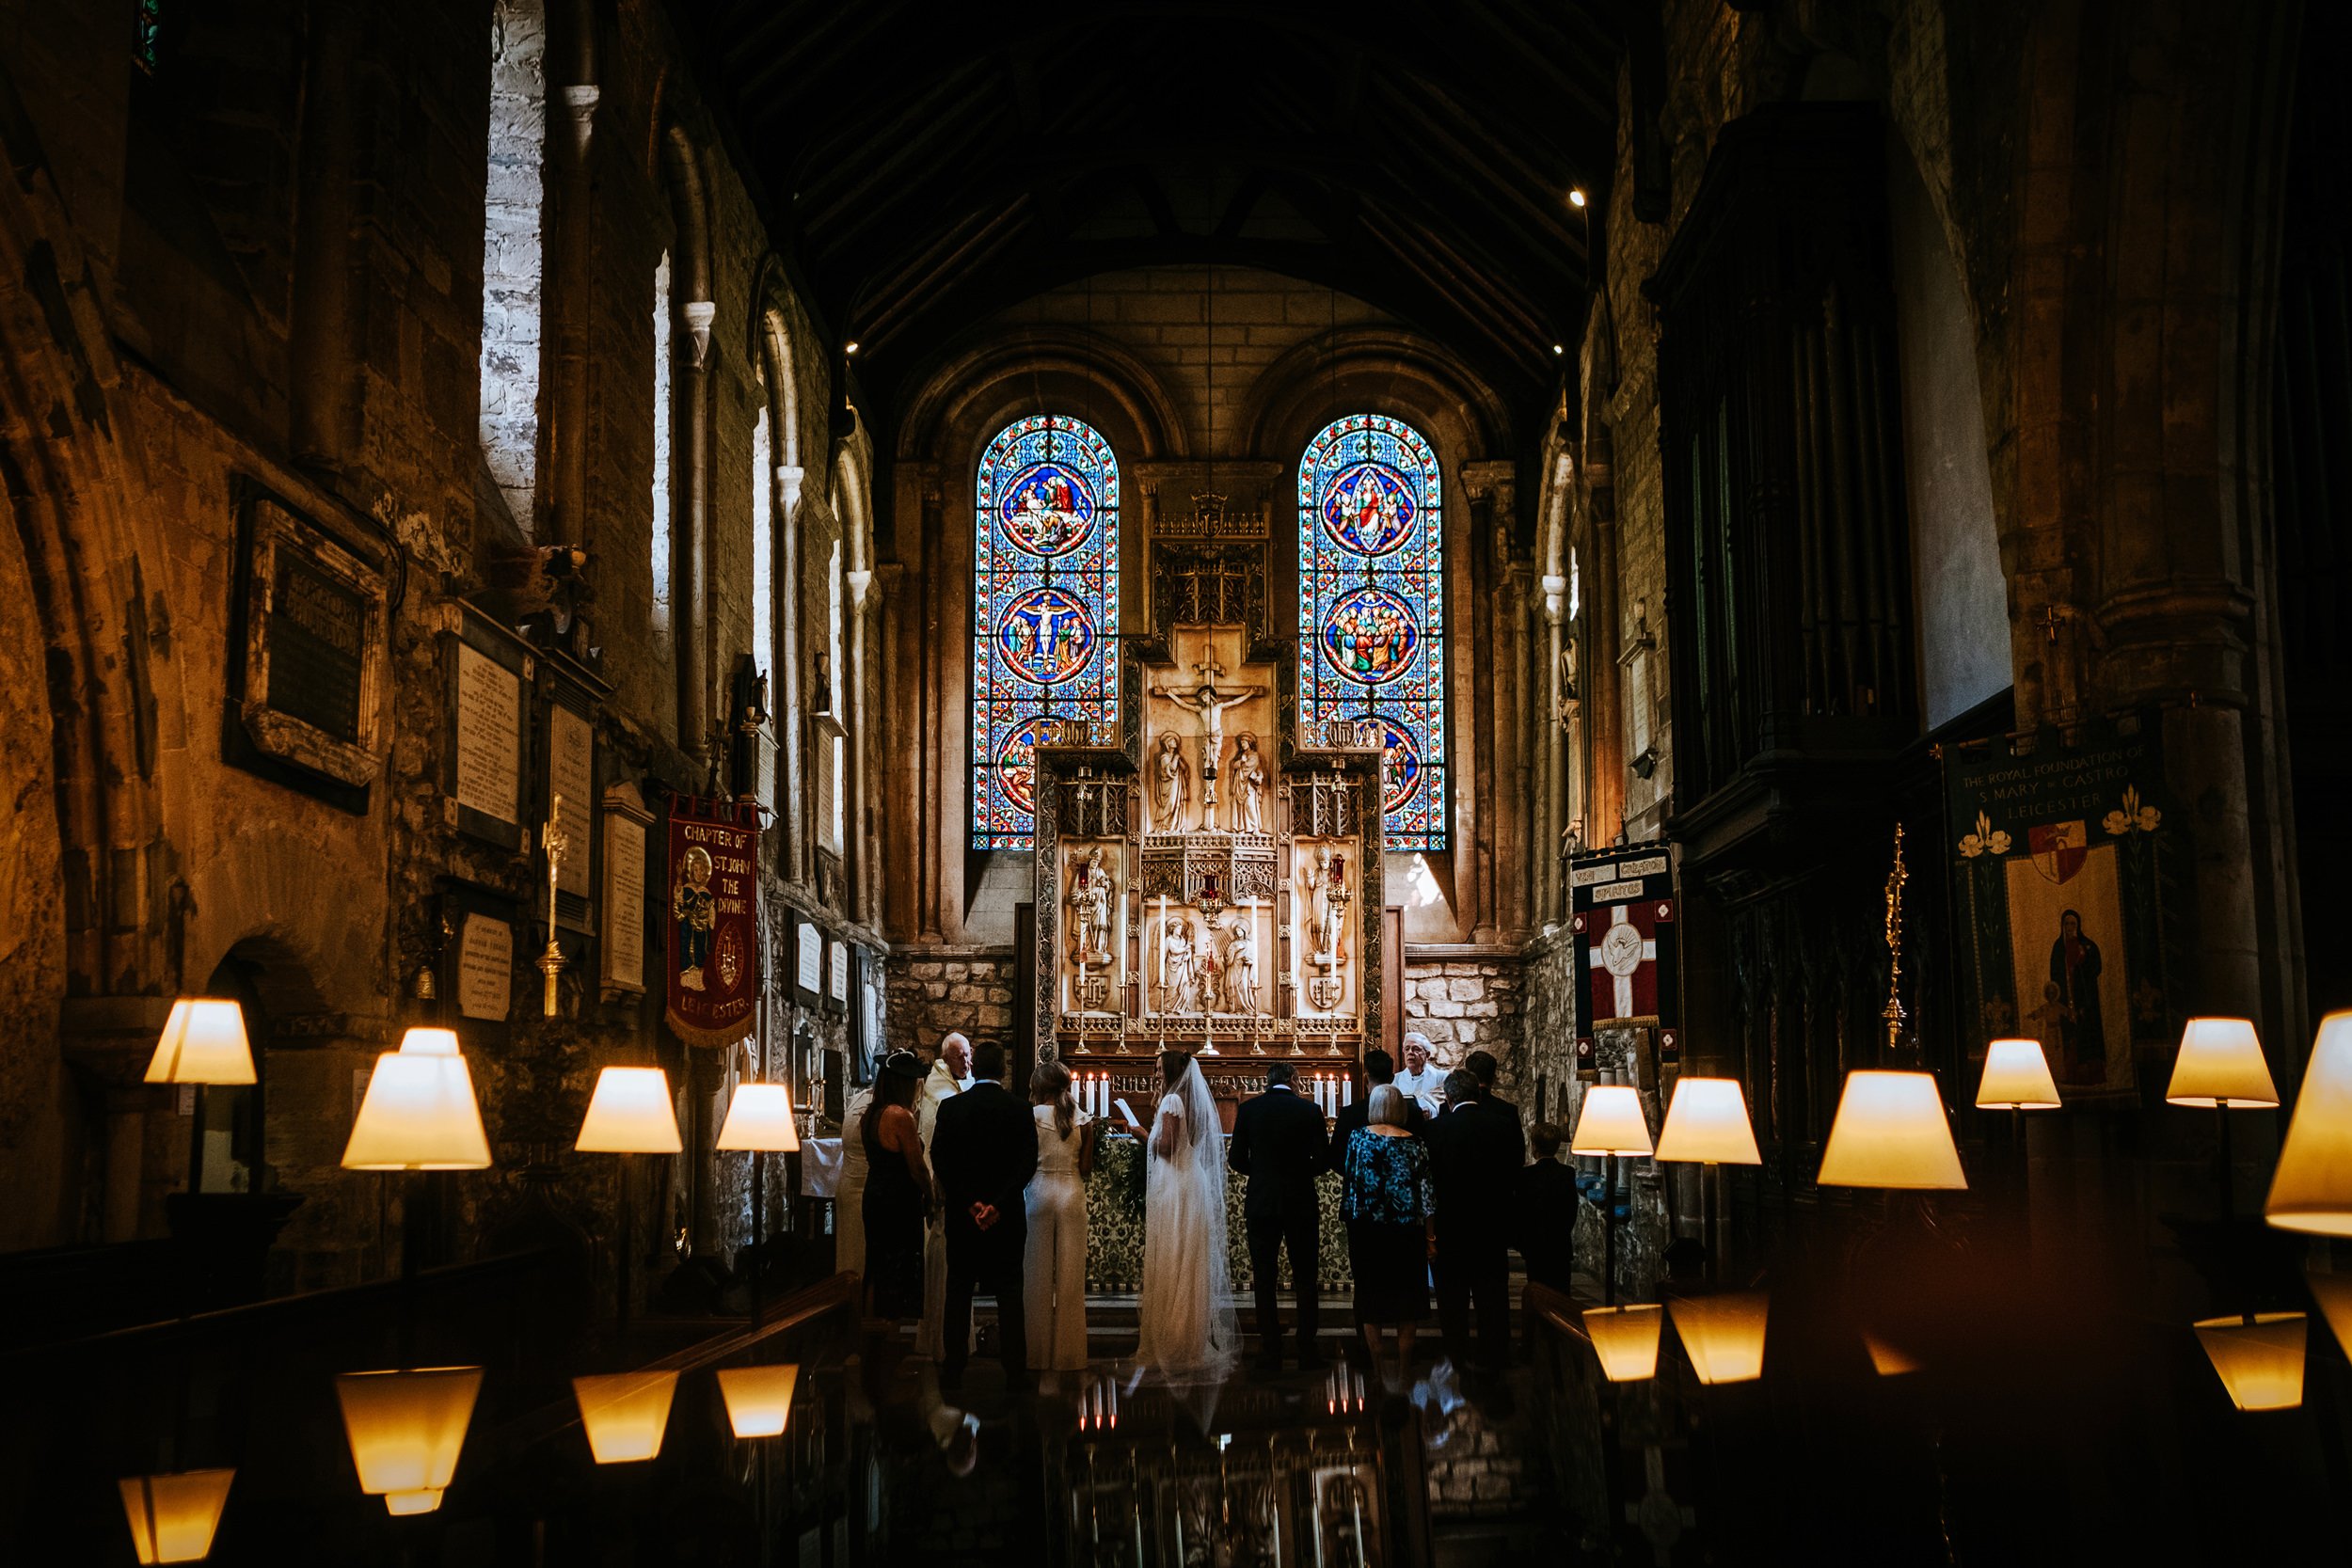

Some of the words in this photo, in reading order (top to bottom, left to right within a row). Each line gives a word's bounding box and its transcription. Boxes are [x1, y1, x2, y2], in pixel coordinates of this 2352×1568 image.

[1963, 776, 1984, 788] THE
[1988, 768, 2032, 784] ROYAL
[2034, 750, 2123, 777] FOUNDATION
[2126, 744, 2146, 759] OF
[1994, 782, 2040, 801] MARY
[2062, 765, 2129, 788] CASTRO
[2008, 792, 2102, 820] LEICESTER
[684, 825, 732, 847] CHAPTER
[735, 834, 748, 849] OF
[717, 897, 747, 915] DIVINE
